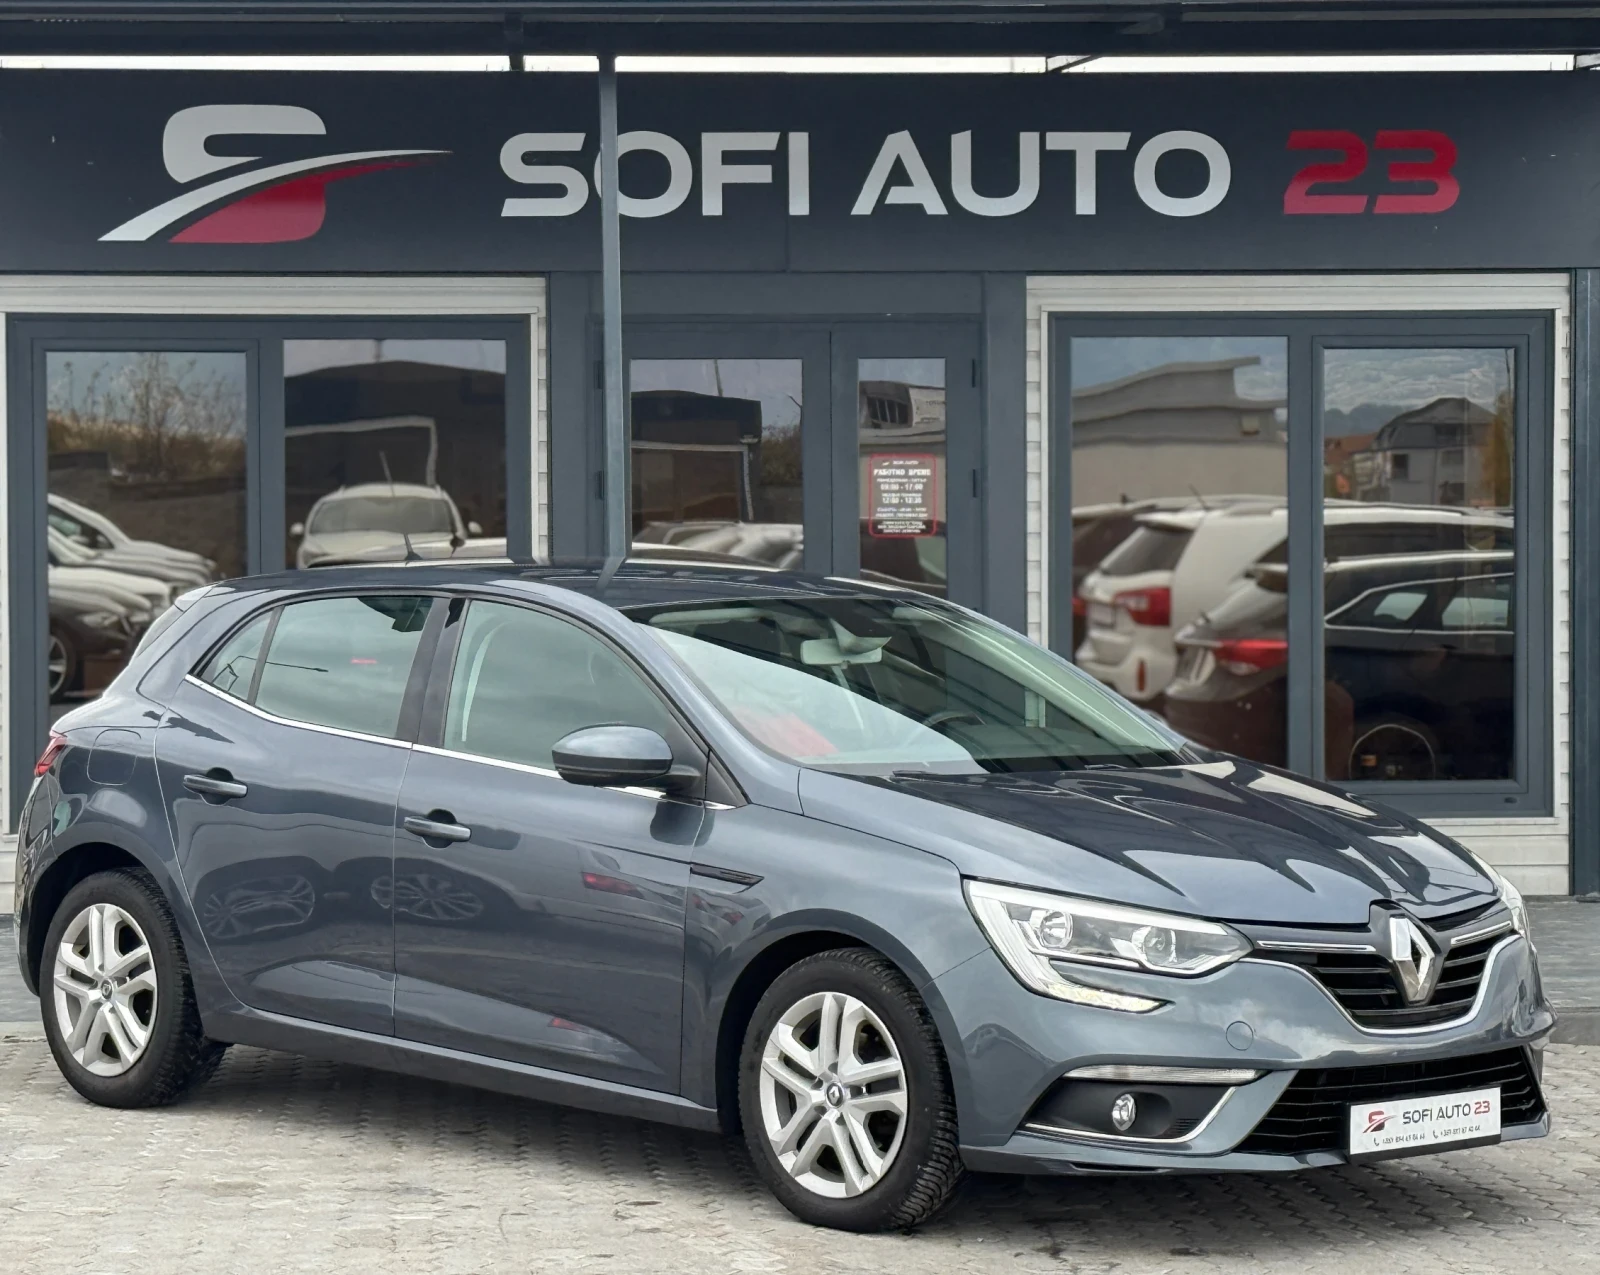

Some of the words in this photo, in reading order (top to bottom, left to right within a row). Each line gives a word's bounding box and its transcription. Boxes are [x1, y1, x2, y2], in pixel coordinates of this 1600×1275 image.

[499, 130, 809, 218] SOFI
[850, 129, 1232, 218] AUTO
[1284, 129, 1460, 215] 23
[1402, 1108, 1433, 1125] SOFI
[1436, 1103, 1471, 1121] AUTO
[1474, 1100, 1490, 1115] 23
